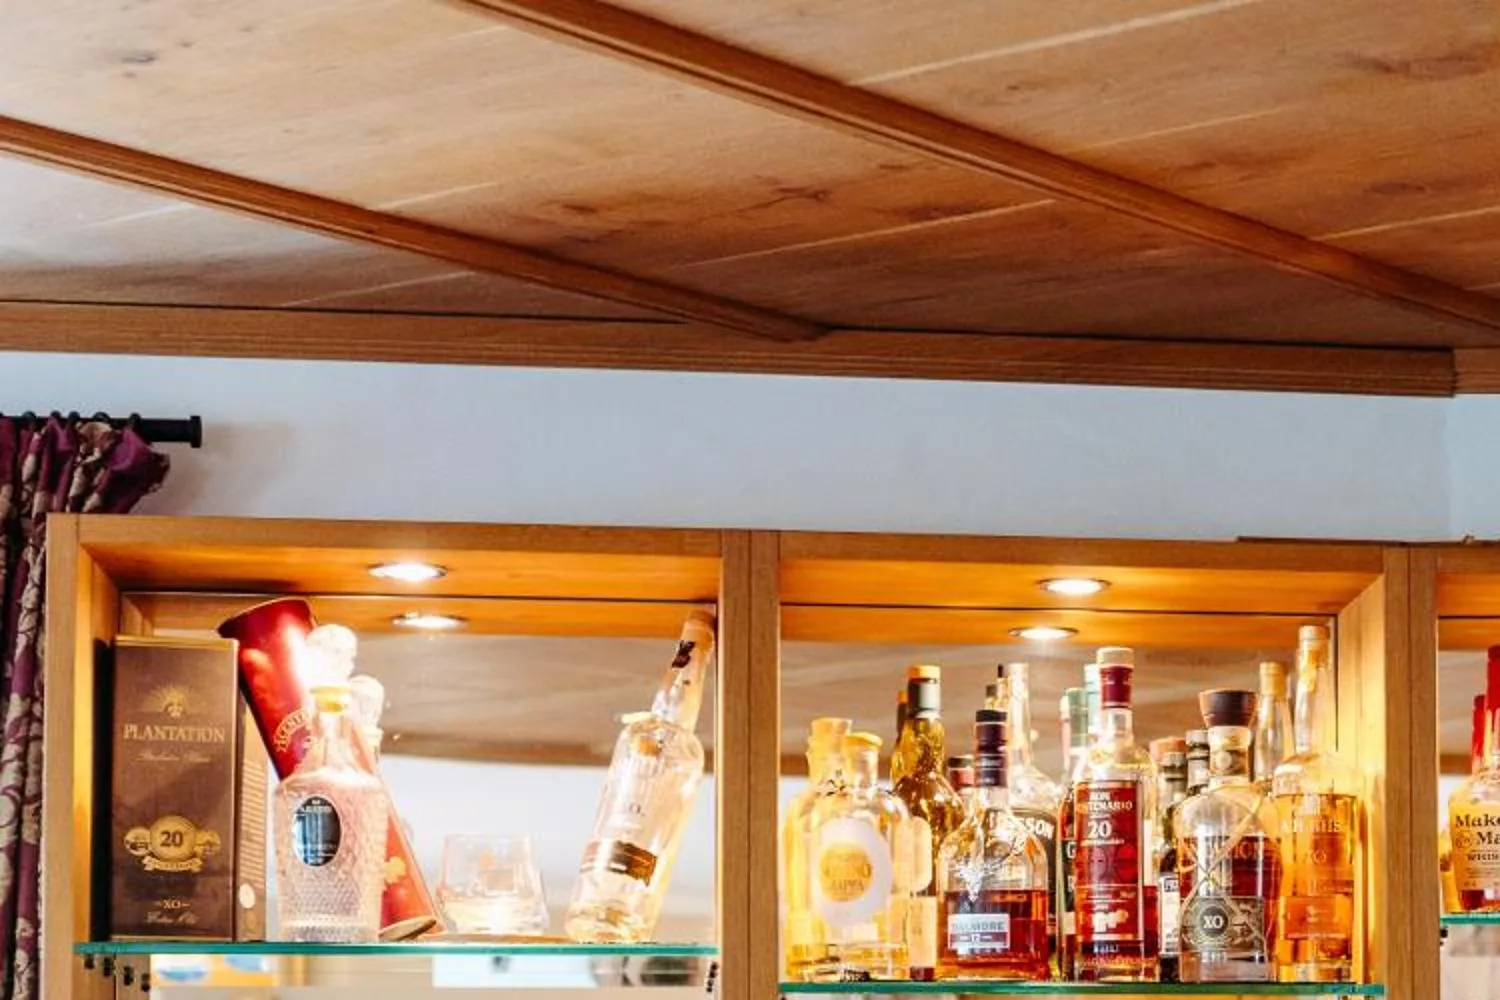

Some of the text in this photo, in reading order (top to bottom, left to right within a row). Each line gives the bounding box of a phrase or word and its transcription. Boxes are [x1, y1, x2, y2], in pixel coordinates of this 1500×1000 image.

[123, 723, 226, 743] PLANTATION
[159, 829, 184, 848] 20
[1087, 820, 1112, 839] 20
[163, 899, 181, 910] XO
[1203, 915, 1224, 929] XO
